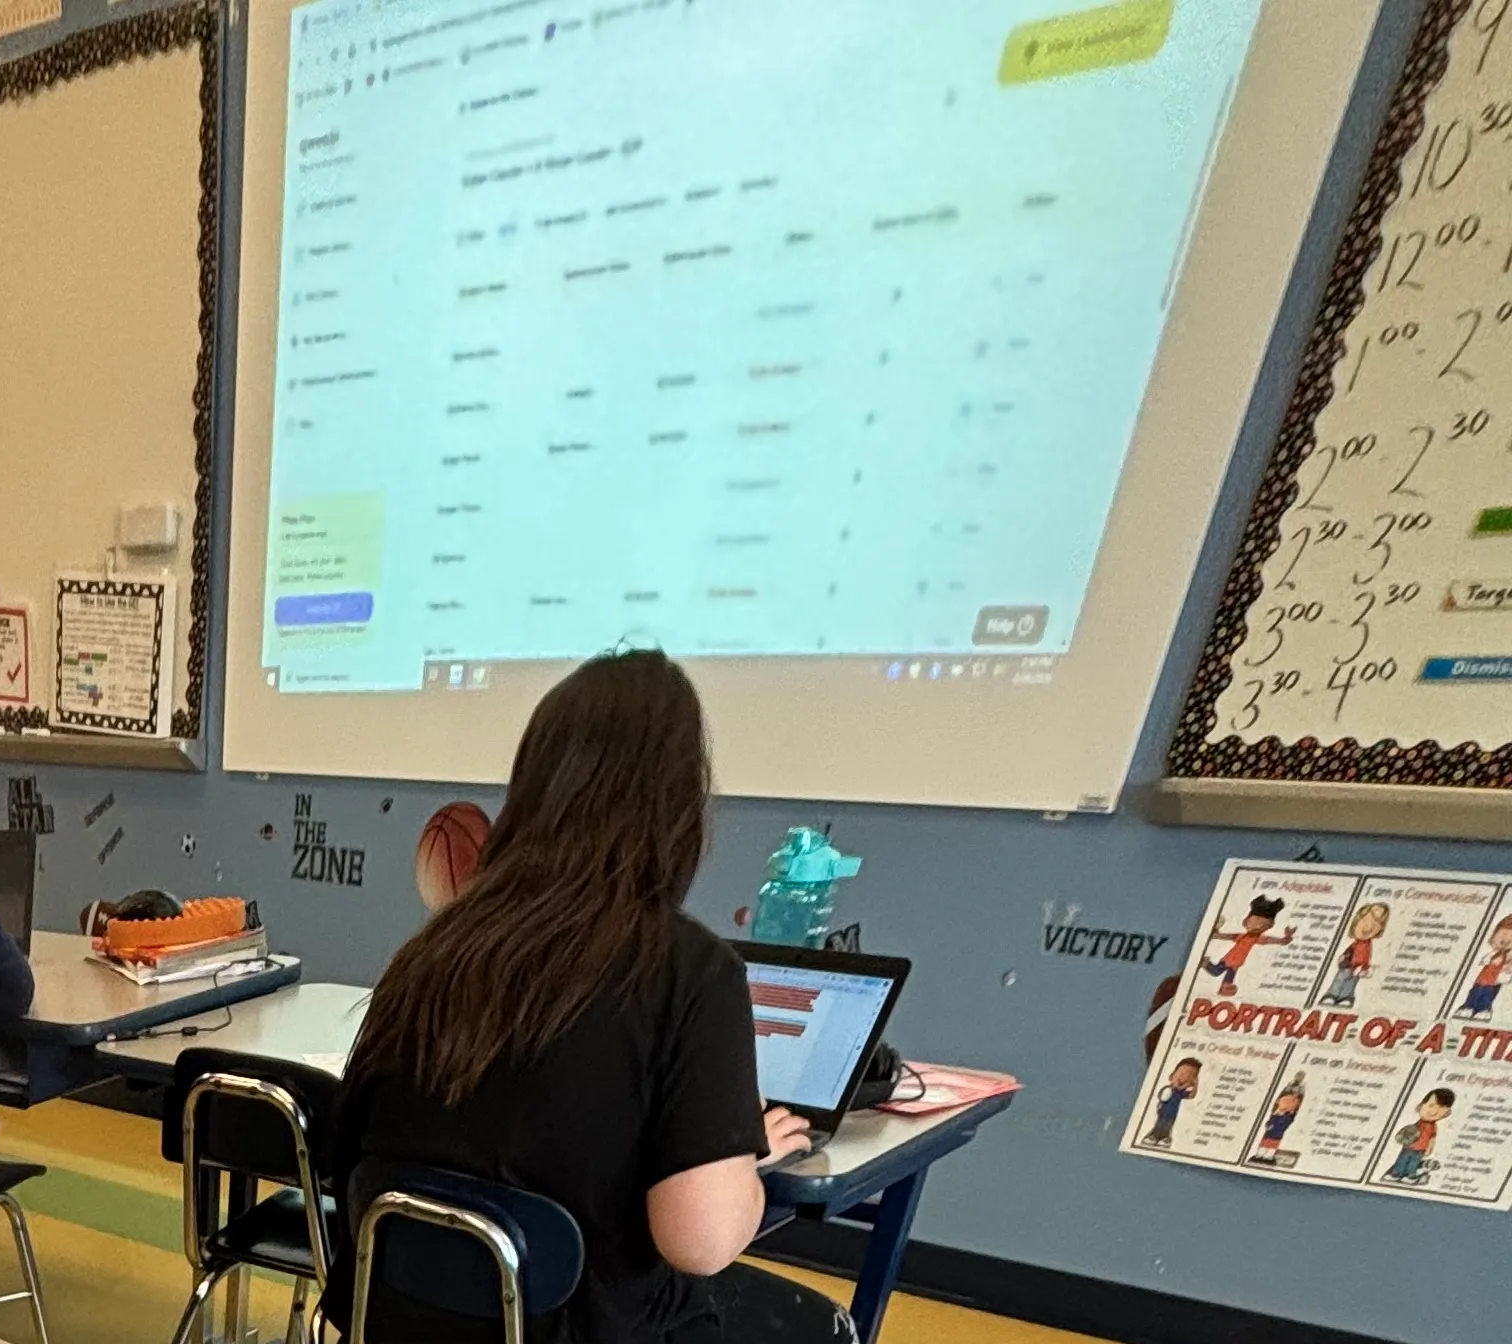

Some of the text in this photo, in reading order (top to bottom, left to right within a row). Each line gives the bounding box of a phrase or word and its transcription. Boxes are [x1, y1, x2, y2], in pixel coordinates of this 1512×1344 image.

[294, 793, 312, 817] IN
[293, 819, 327, 845] THE
[291, 844, 365, 888] ZONE
[1373, 887, 1393, 897] am
[1404, 886, 1490, 905] Communicator
[1043, 923, 1169, 965] VICTORY
[1186, 998, 1358, 1044] PORTRAIT
[1359, 1017, 1417, 1049] OF
[1415, 1023, 1446, 1054] A
